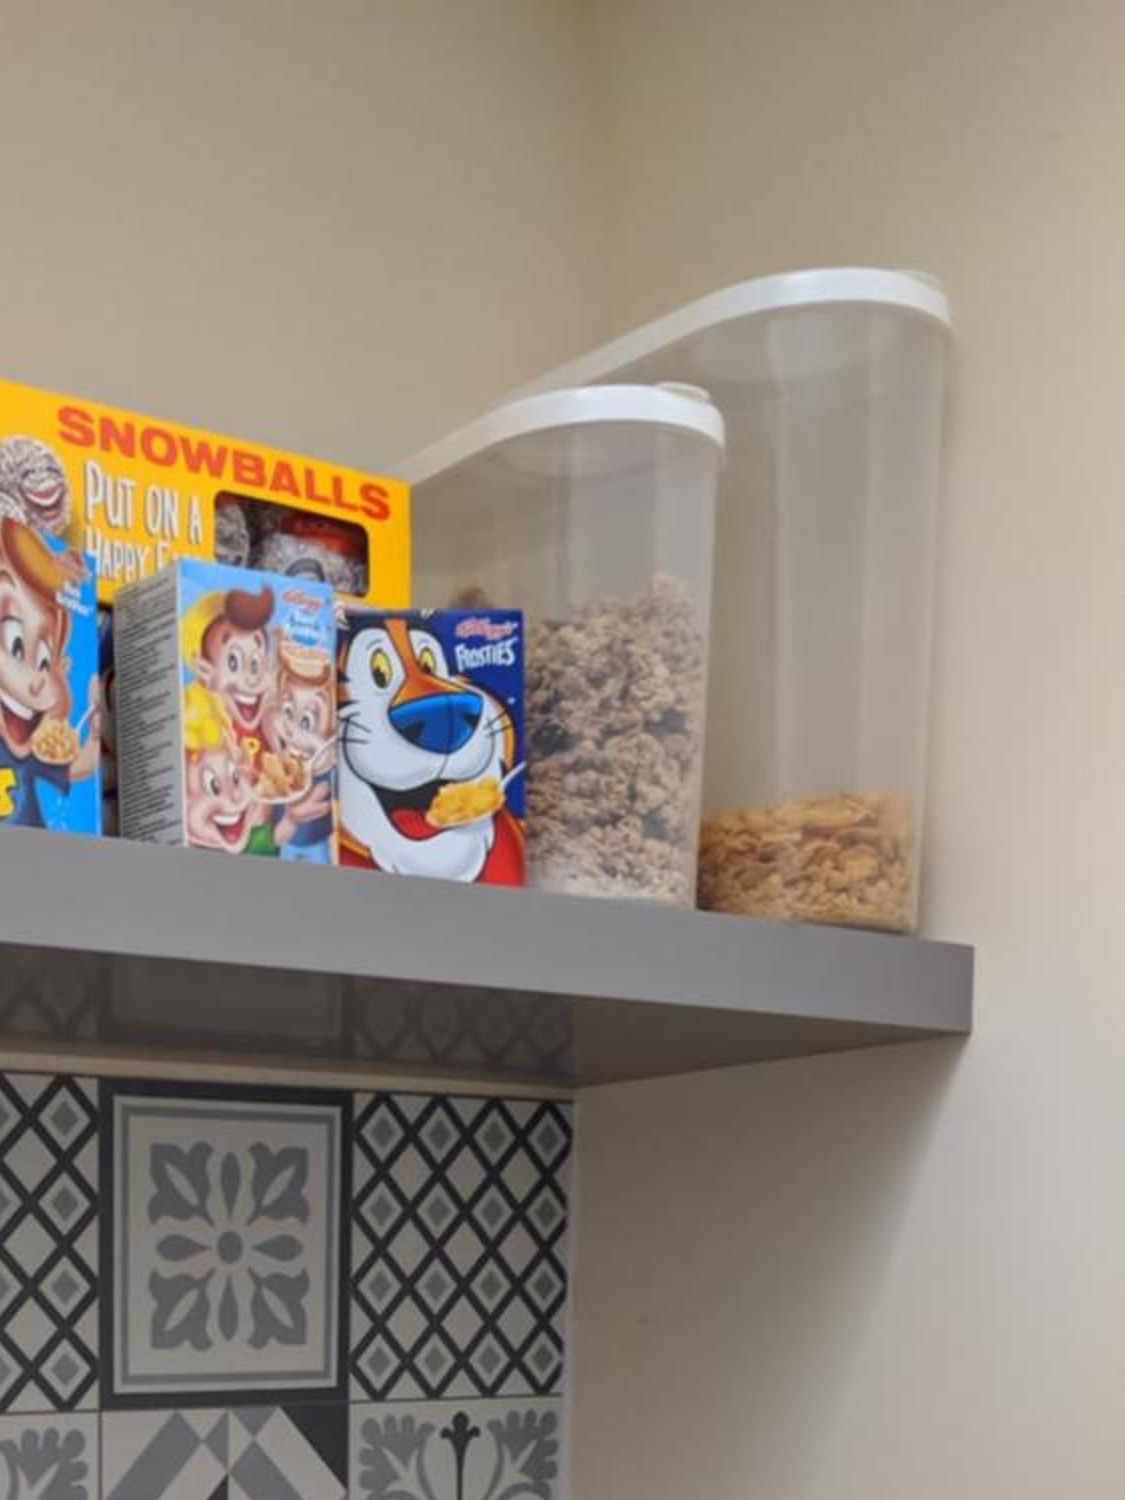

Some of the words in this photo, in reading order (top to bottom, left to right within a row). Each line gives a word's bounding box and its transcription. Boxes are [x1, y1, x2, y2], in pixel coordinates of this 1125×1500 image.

[58, 406, 391, 521] SNOWBALLS
[84, 460, 136, 528] PUT
[145, 484, 179, 538] ON
[189, 496, 203, 545] A
